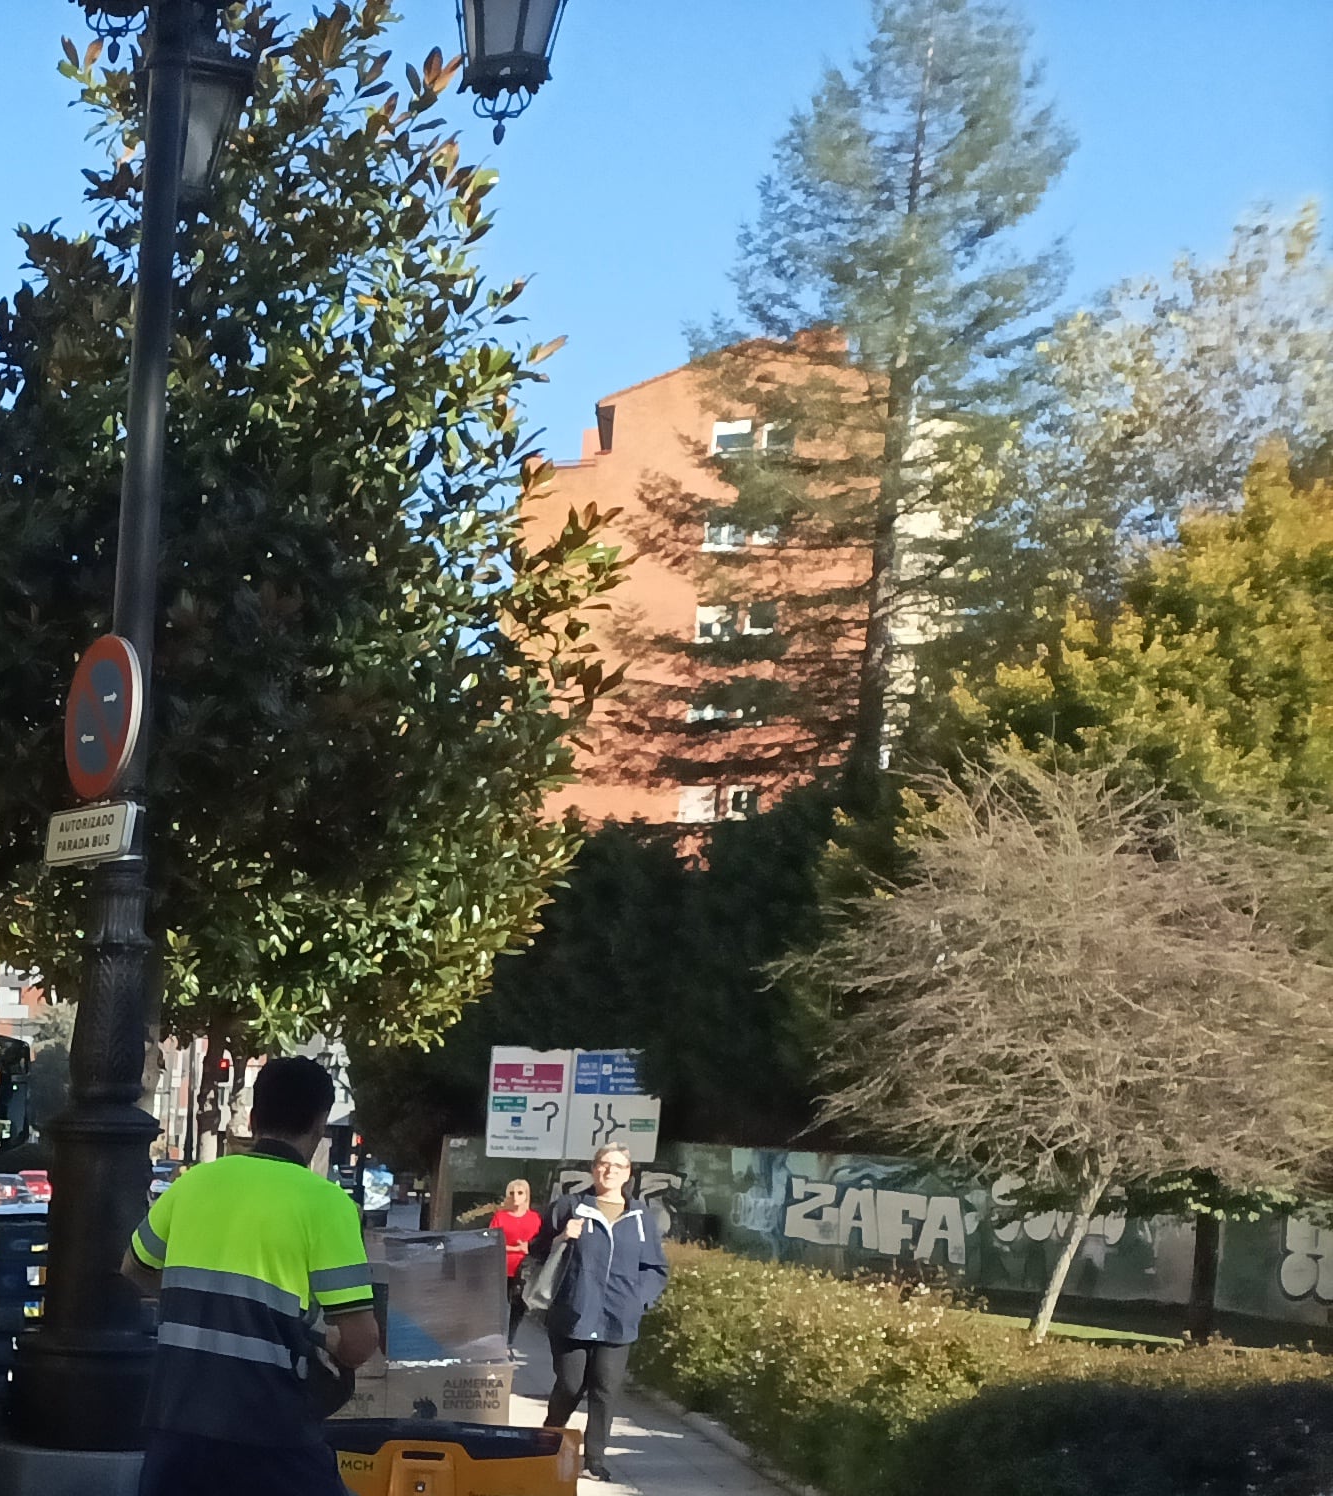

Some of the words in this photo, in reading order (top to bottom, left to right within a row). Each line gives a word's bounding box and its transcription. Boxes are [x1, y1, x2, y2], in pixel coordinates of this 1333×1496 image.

[59, 814, 114, 832] AUTORIZADO
[57, 837, 89, 852] PARADA
[91, 834, 110, 848] BUS
[443, 1378, 504, 1390] ALIMERKA
[443, 1389, 481, 1400] CUIDA
[485, 1390, 499, 1400] MI
[443, 1400, 501, 1411] ENTORNO
[341, 1459, 373, 1471] MCH
